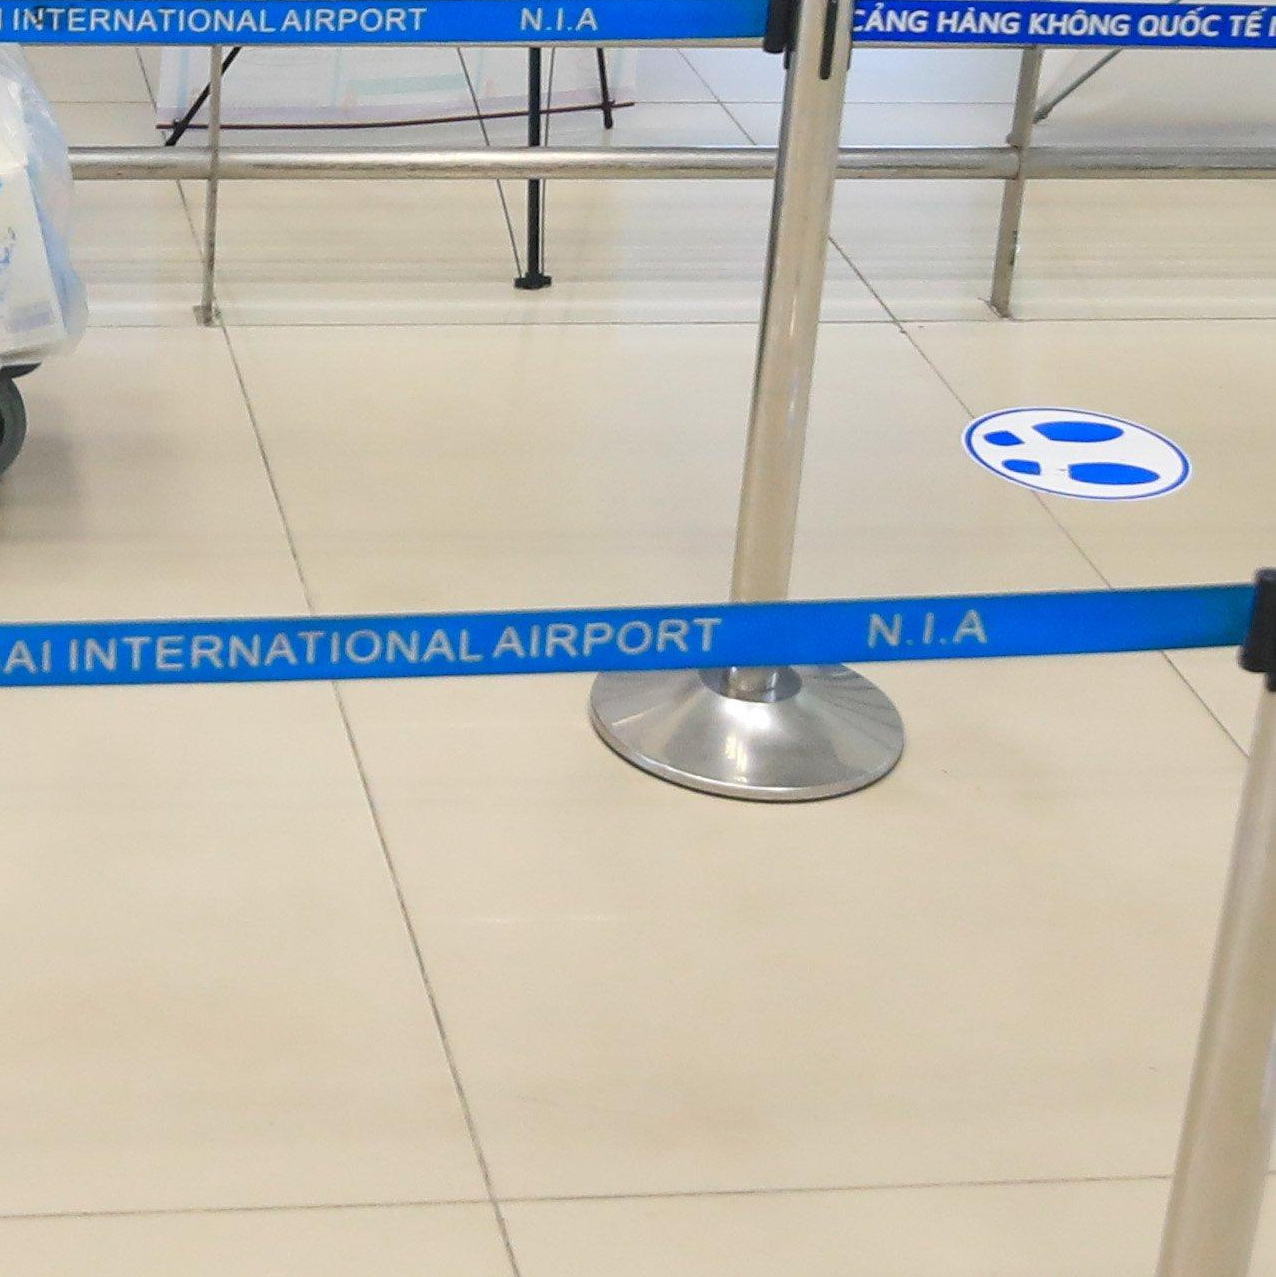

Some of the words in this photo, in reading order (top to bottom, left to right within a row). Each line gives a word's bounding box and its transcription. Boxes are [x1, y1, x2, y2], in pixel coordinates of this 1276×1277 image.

[11, 6, 276, 33] INTERNATIONAL
[281, 7, 428, 33] AIRPORT
[519, 6, 598, 33] N.I.A
[936, 5, 1021, 34] HÀNG
[1027, 7, 1130, 37] KHÔNG
[1137, 5, 1221, 38] QUỐC
[1229, 7, 1265, 38] TẾ
[68, 628, 484, 675] INTERNATIONAL
[493, 617, 724, 658] AIRPORT
[868, 609, 988, 648] N.I.A
